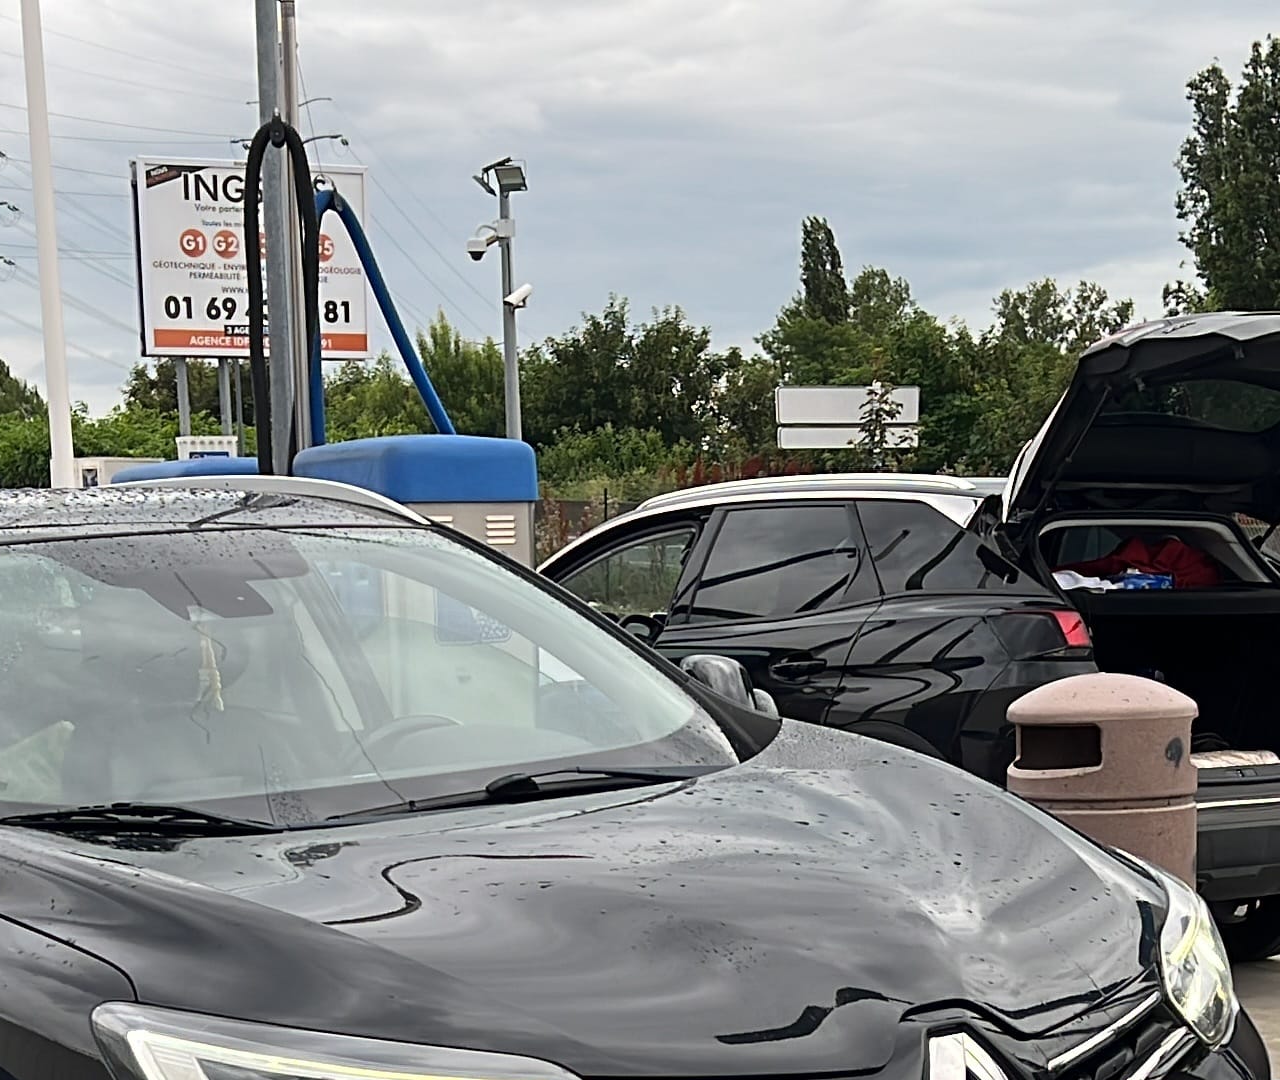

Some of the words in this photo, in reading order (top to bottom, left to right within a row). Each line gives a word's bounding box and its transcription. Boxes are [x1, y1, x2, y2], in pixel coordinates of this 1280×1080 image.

[182, 234, 204, 251] G1
[213, 236, 239, 253] G2
[164, 295, 194, 320] 01
[206, 297, 237, 321] 69
[324, 300, 351, 324] 81
[226, 326, 233, 335] 3
[189, 335, 232, 346] AGENCE
